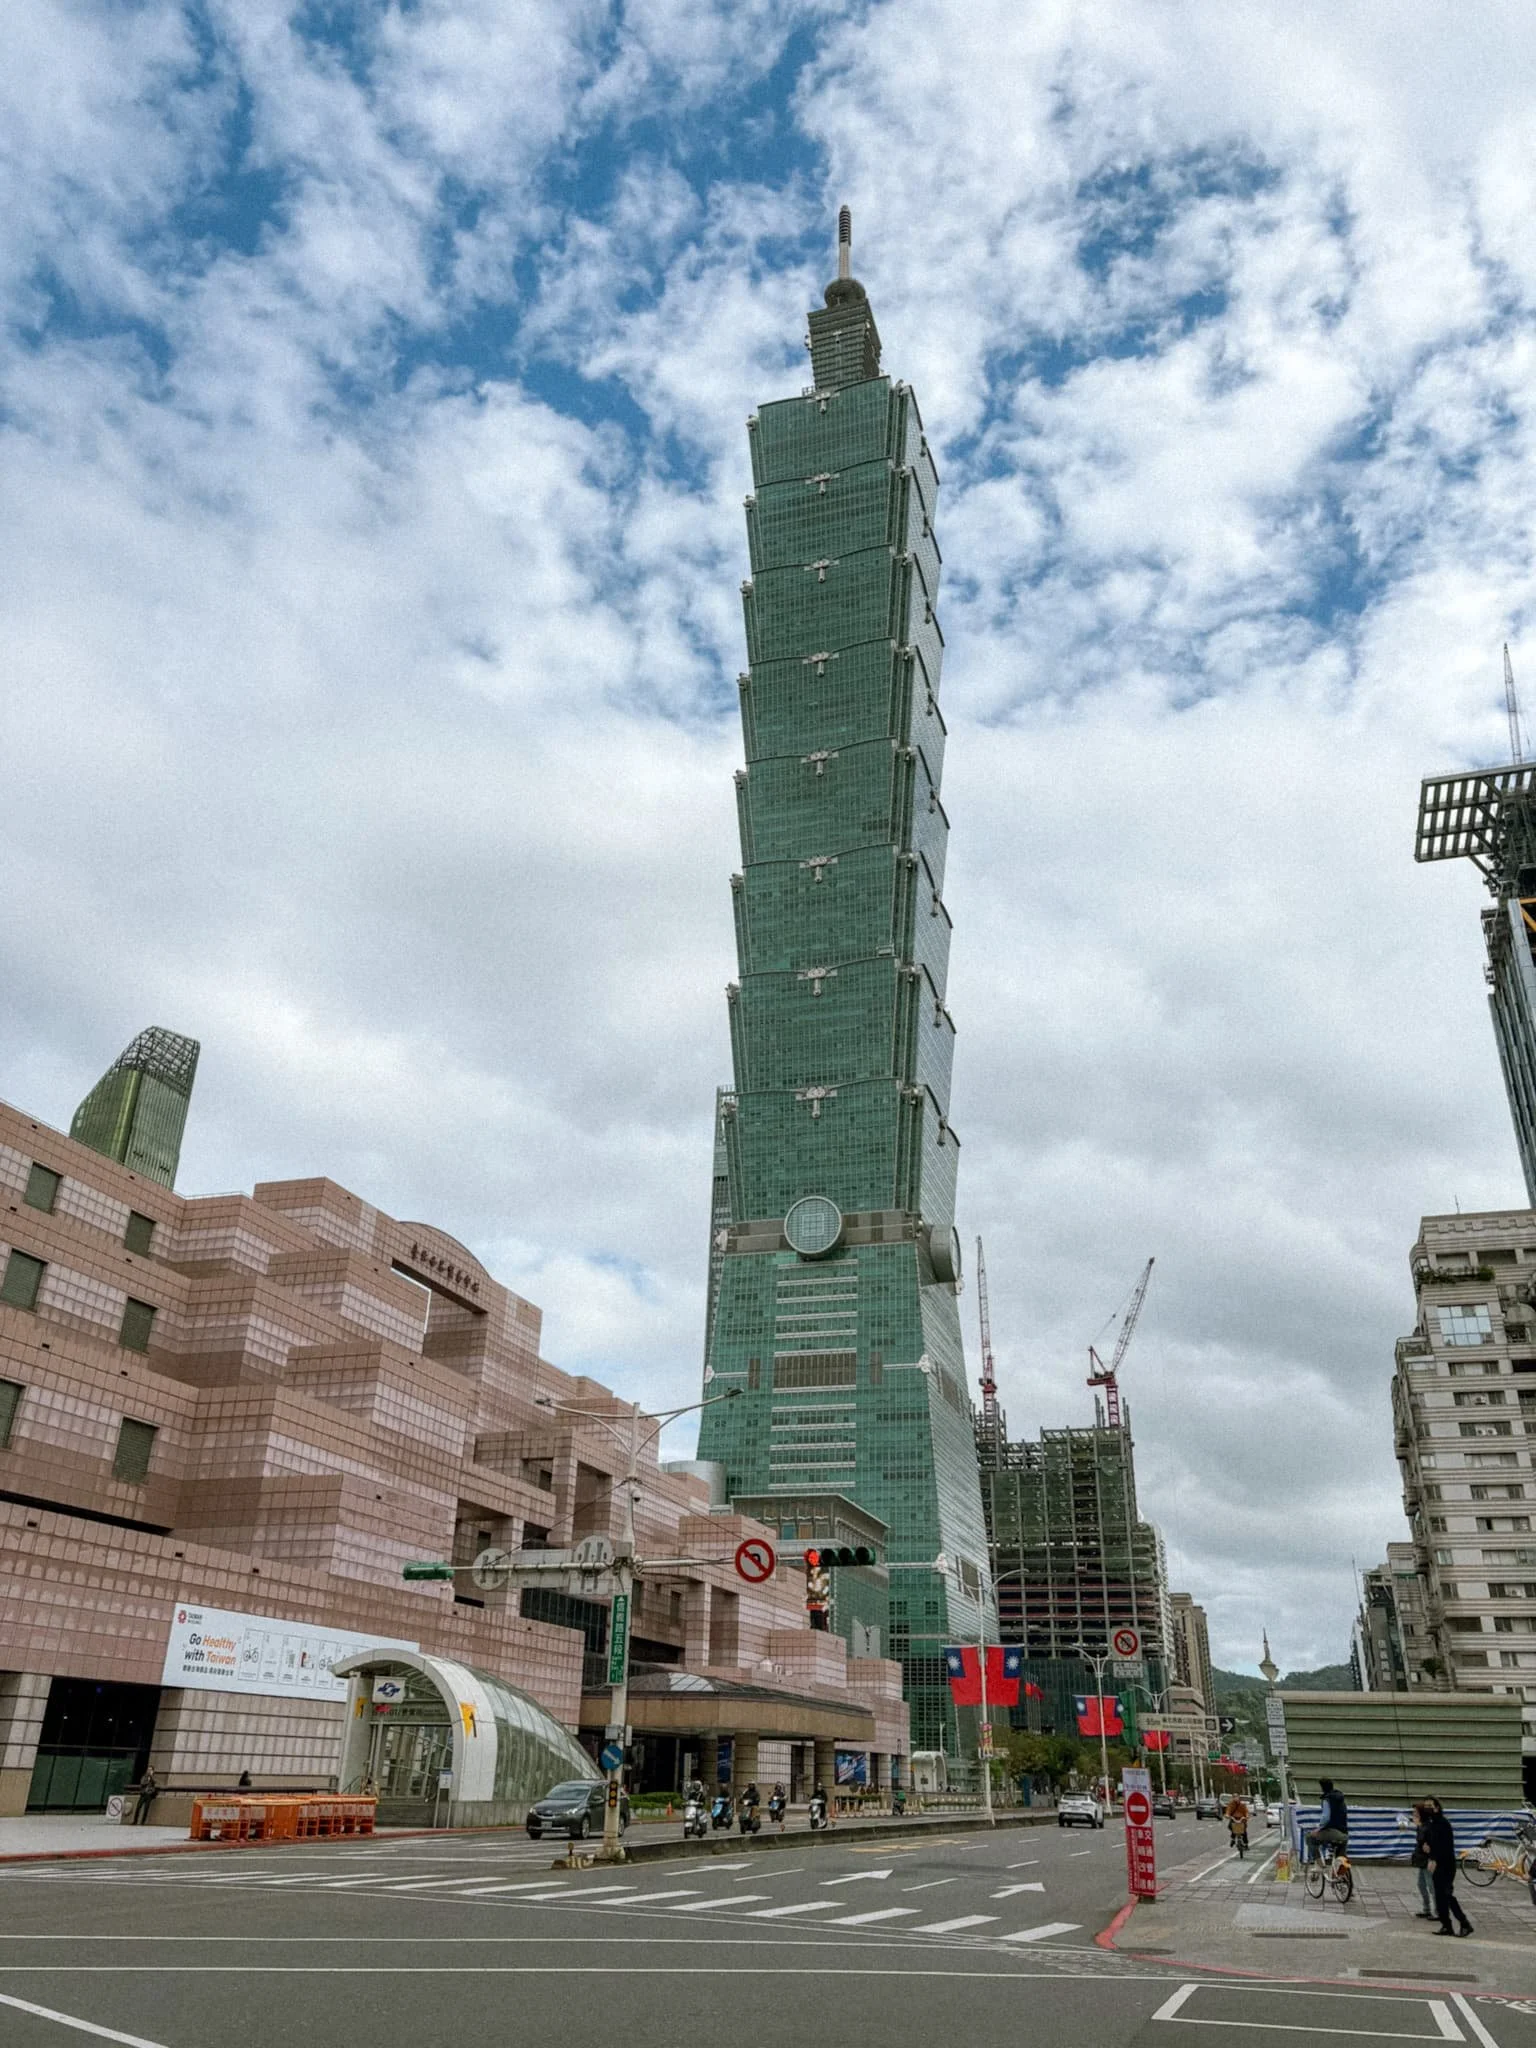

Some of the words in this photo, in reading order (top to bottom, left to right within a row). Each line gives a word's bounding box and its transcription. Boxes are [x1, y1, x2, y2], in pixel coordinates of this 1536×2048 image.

[189, 1633, 202, 1646] Go
[202, 1634, 237, 1652] Healthy
[184, 1648, 205, 1662] with
[206, 1651, 237, 1665] Taiwan
[469, 1711, 477, 1738] 1
